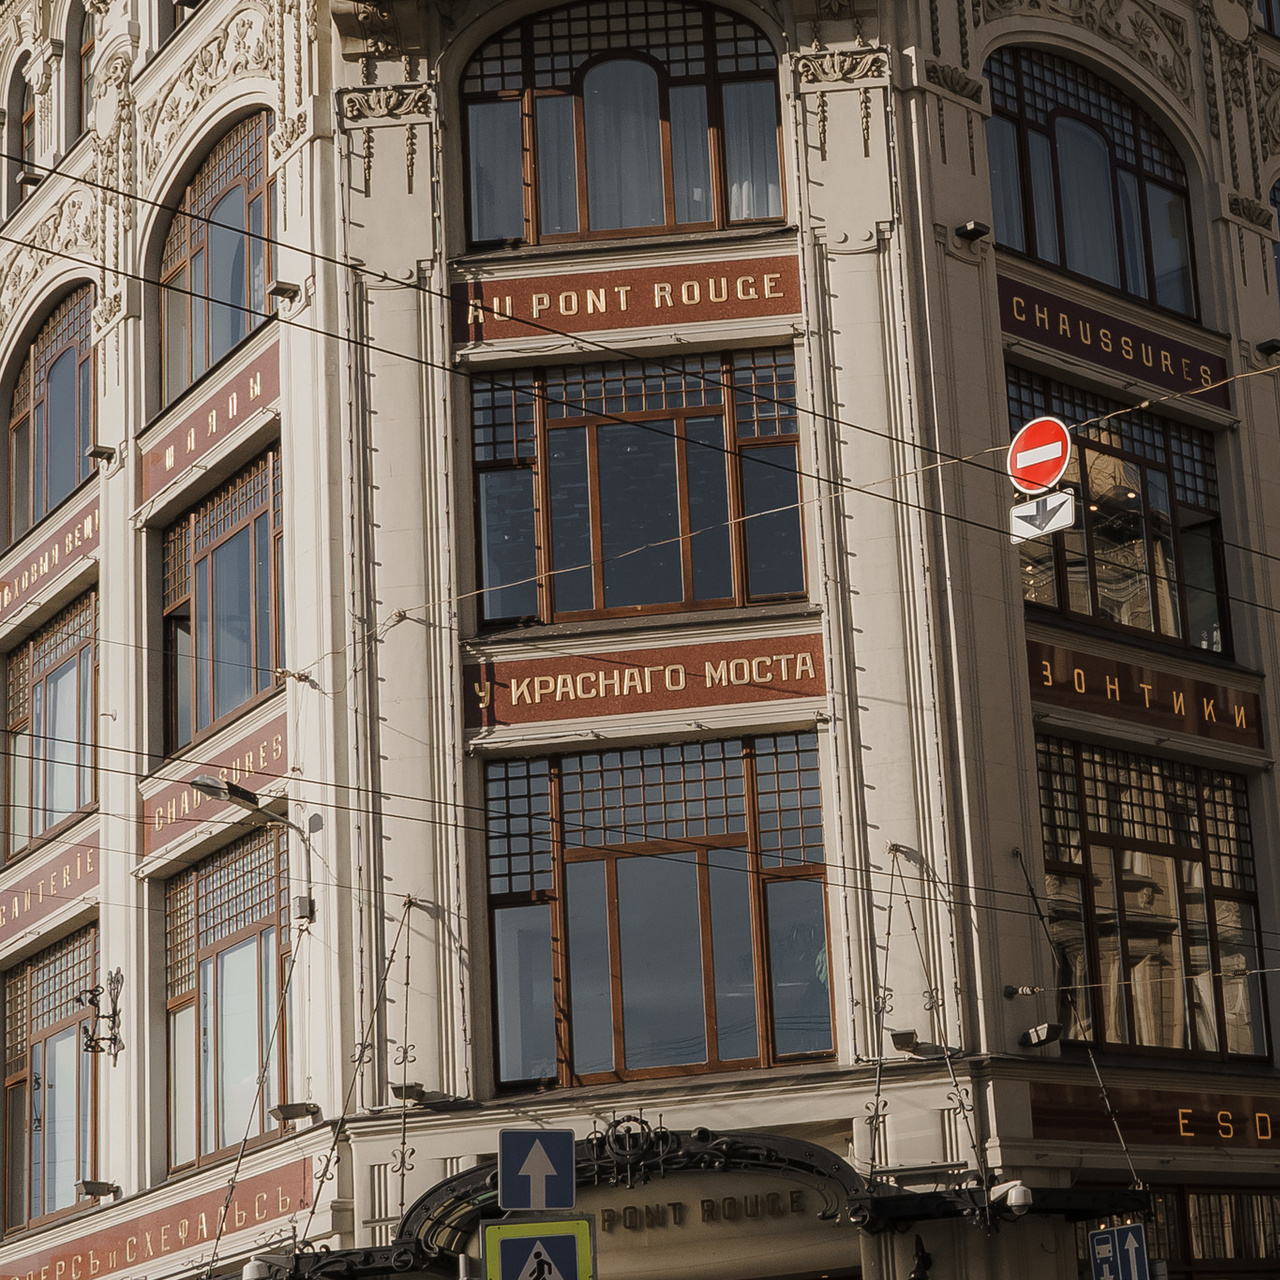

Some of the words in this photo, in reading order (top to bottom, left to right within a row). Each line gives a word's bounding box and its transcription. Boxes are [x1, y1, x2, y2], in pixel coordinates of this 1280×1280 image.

[467, 295, 512, 324] AU
[532, 284, 632, 319] PONT
[653, 272, 785, 309] ROUGE
[1012, 295, 1213, 388] CHAUSSURES
[165, 371, 261, 472] ШЛЯПЫ
[474, 681, 490, 709] У
[510, 663, 686, 706] КРАСНАГО
[704, 651, 816, 687] МОСТА
[1041, 660, 1246, 730] ЗОНТИКИ
[155, 732, 283, 832] CHAUSURES
[601, 1201, 685, 1232] PONT
[701, 1190, 806, 1222] ROUGE
